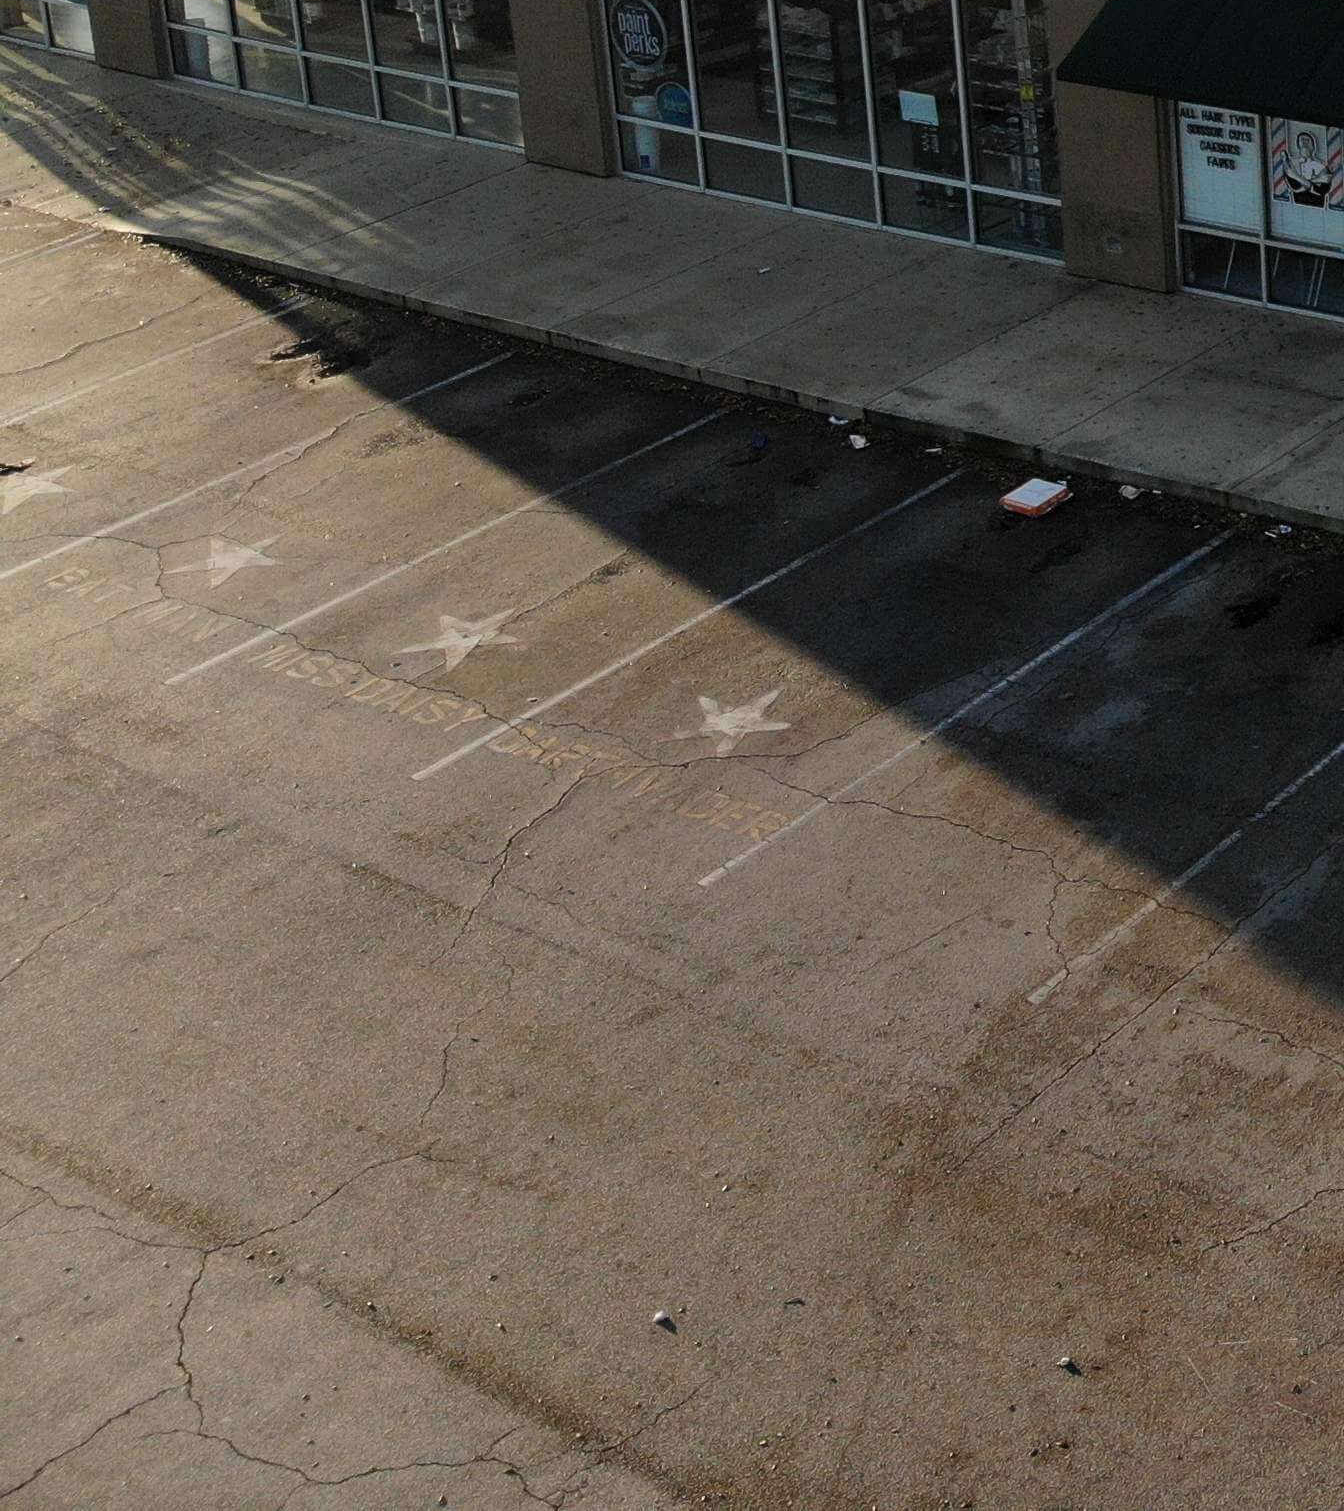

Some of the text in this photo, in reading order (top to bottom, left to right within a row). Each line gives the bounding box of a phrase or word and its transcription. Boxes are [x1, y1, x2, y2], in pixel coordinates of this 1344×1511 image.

[617, 9, 651, 35] paint
[624, 31, 661, 57] perks
[341, 676, 490, 733] DAISY
